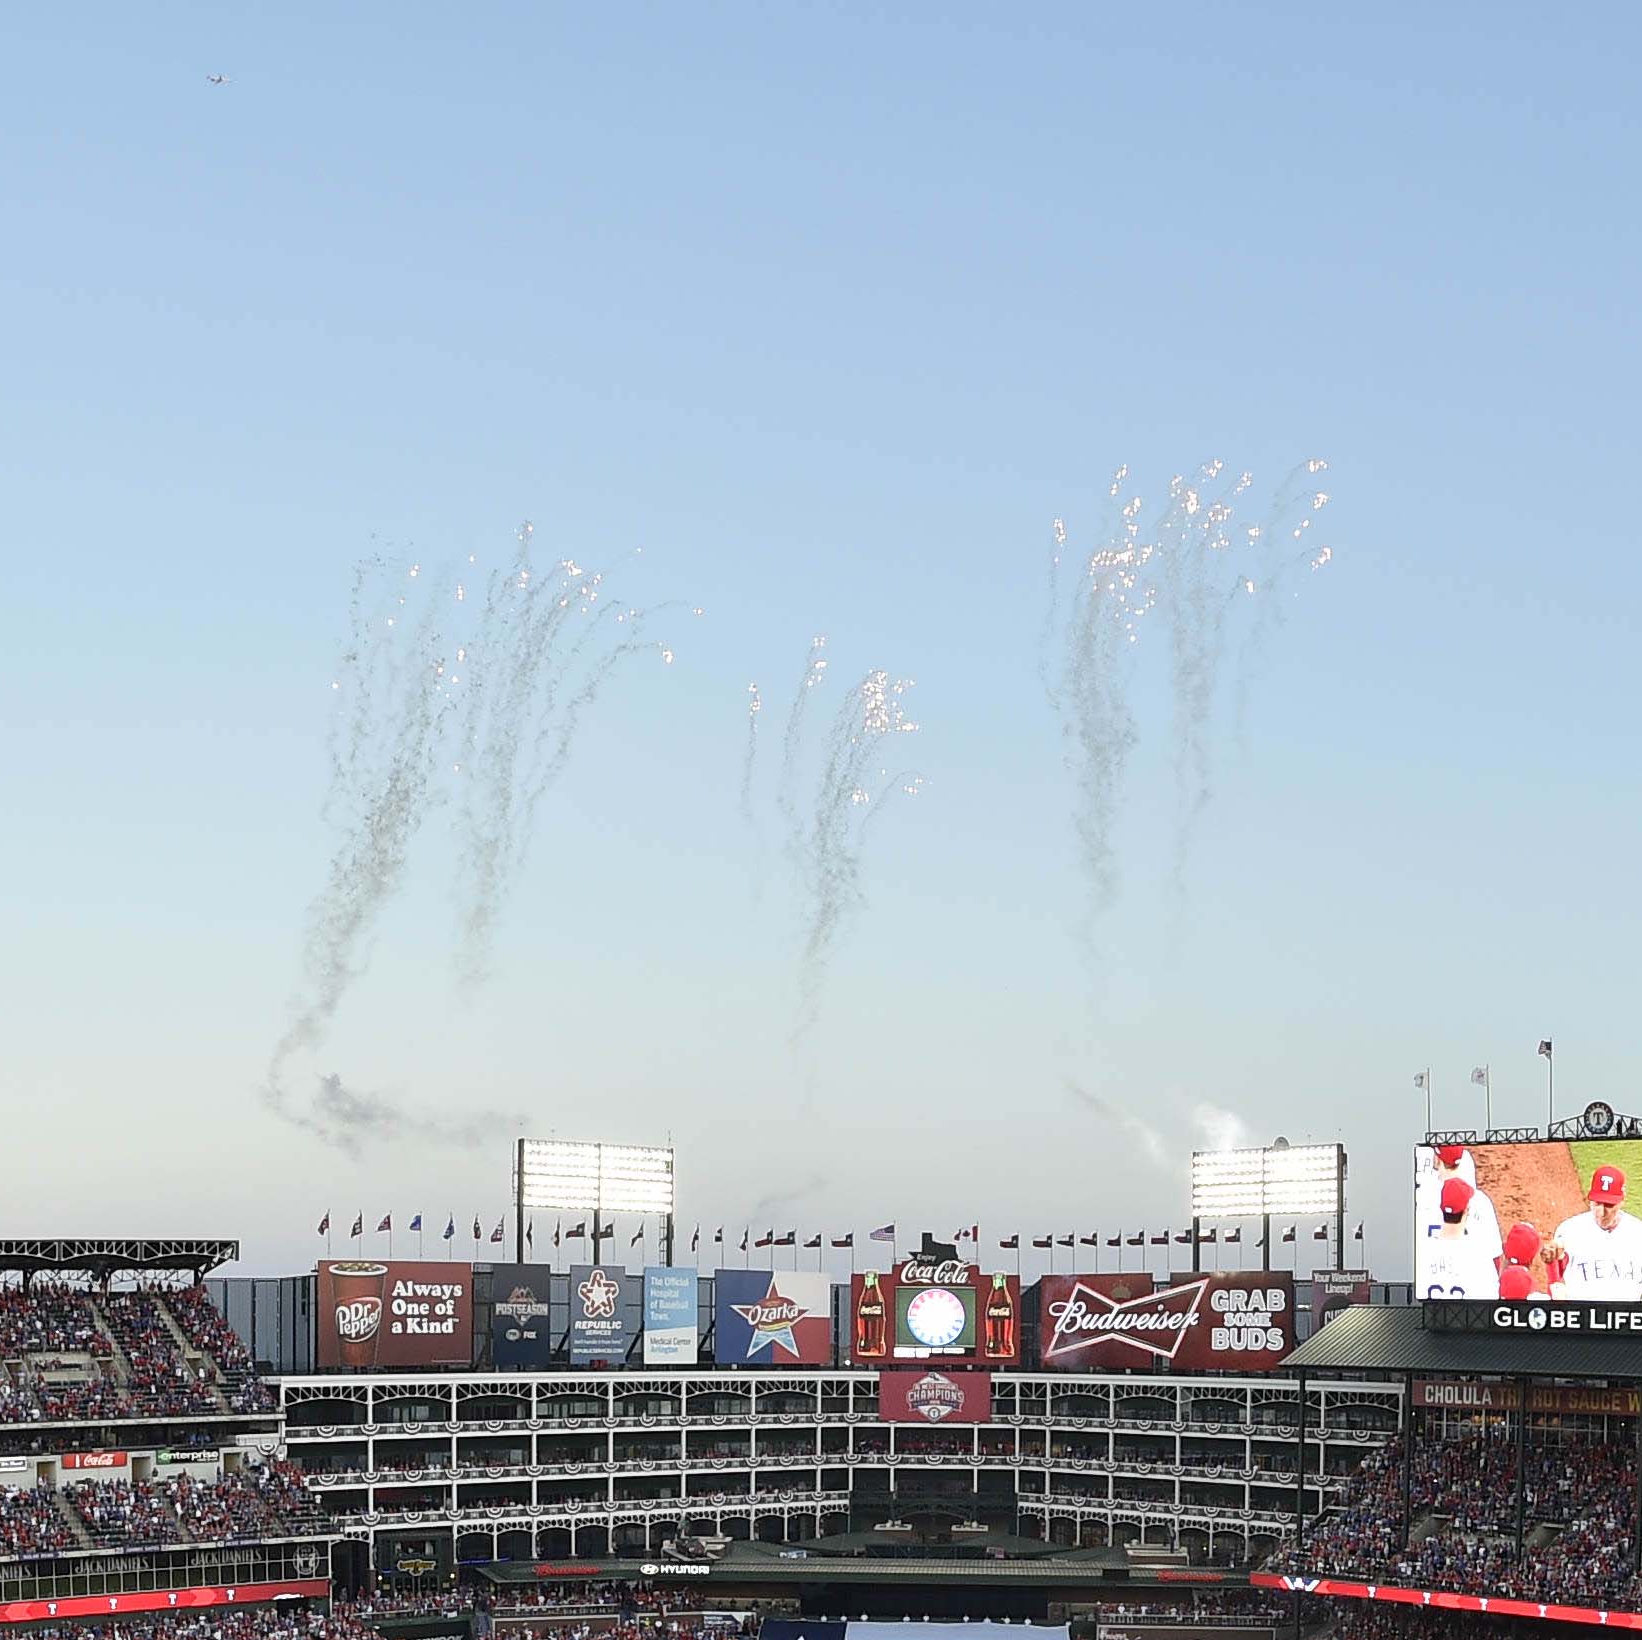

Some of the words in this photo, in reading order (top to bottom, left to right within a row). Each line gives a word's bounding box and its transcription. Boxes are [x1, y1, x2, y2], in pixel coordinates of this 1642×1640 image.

[917, 1253, 936, 1262] Enjoy
[901, 1260, 970, 1283] Coca-Cola
[1314, 1272, 1330, 1284] Your
[1331, 1272, 1366, 1283] Weekend
[392, 1280, 463, 1297] Always
[392, 1299, 429, 1315] One
[435, 1300, 455, 1315] of
[1211, 1289, 1285, 1312] GRAB
[495, 1303, 548, 1316] POSTSEASON
[748, 1303, 798, 1325] Ozarka
[335, 1306, 381, 1338] Pepper
[1049, 1301, 1199, 1334] Budweiser
[1224, 1312, 1271, 1327] SOME
[1493, 1307, 1580, 1330] GLOBE
[392, 1321, 403, 1334] a
[575, 1321, 622, 1330] REPUBLIC
[523, 1331, 537, 1339] FOX
[1211, 1329, 1284, 1351] BUDS
[908, 1390, 964, 1401] CHAMPIONS
[1424, 1385, 1492, 1405] CHOLULA
[160, 1450, 219, 1461] enterprise
[75, 1559, 105, 1573] JACK
[190, 1551, 217, 1566] JACK
[660, 1565, 710, 1574] HYUNDAI
